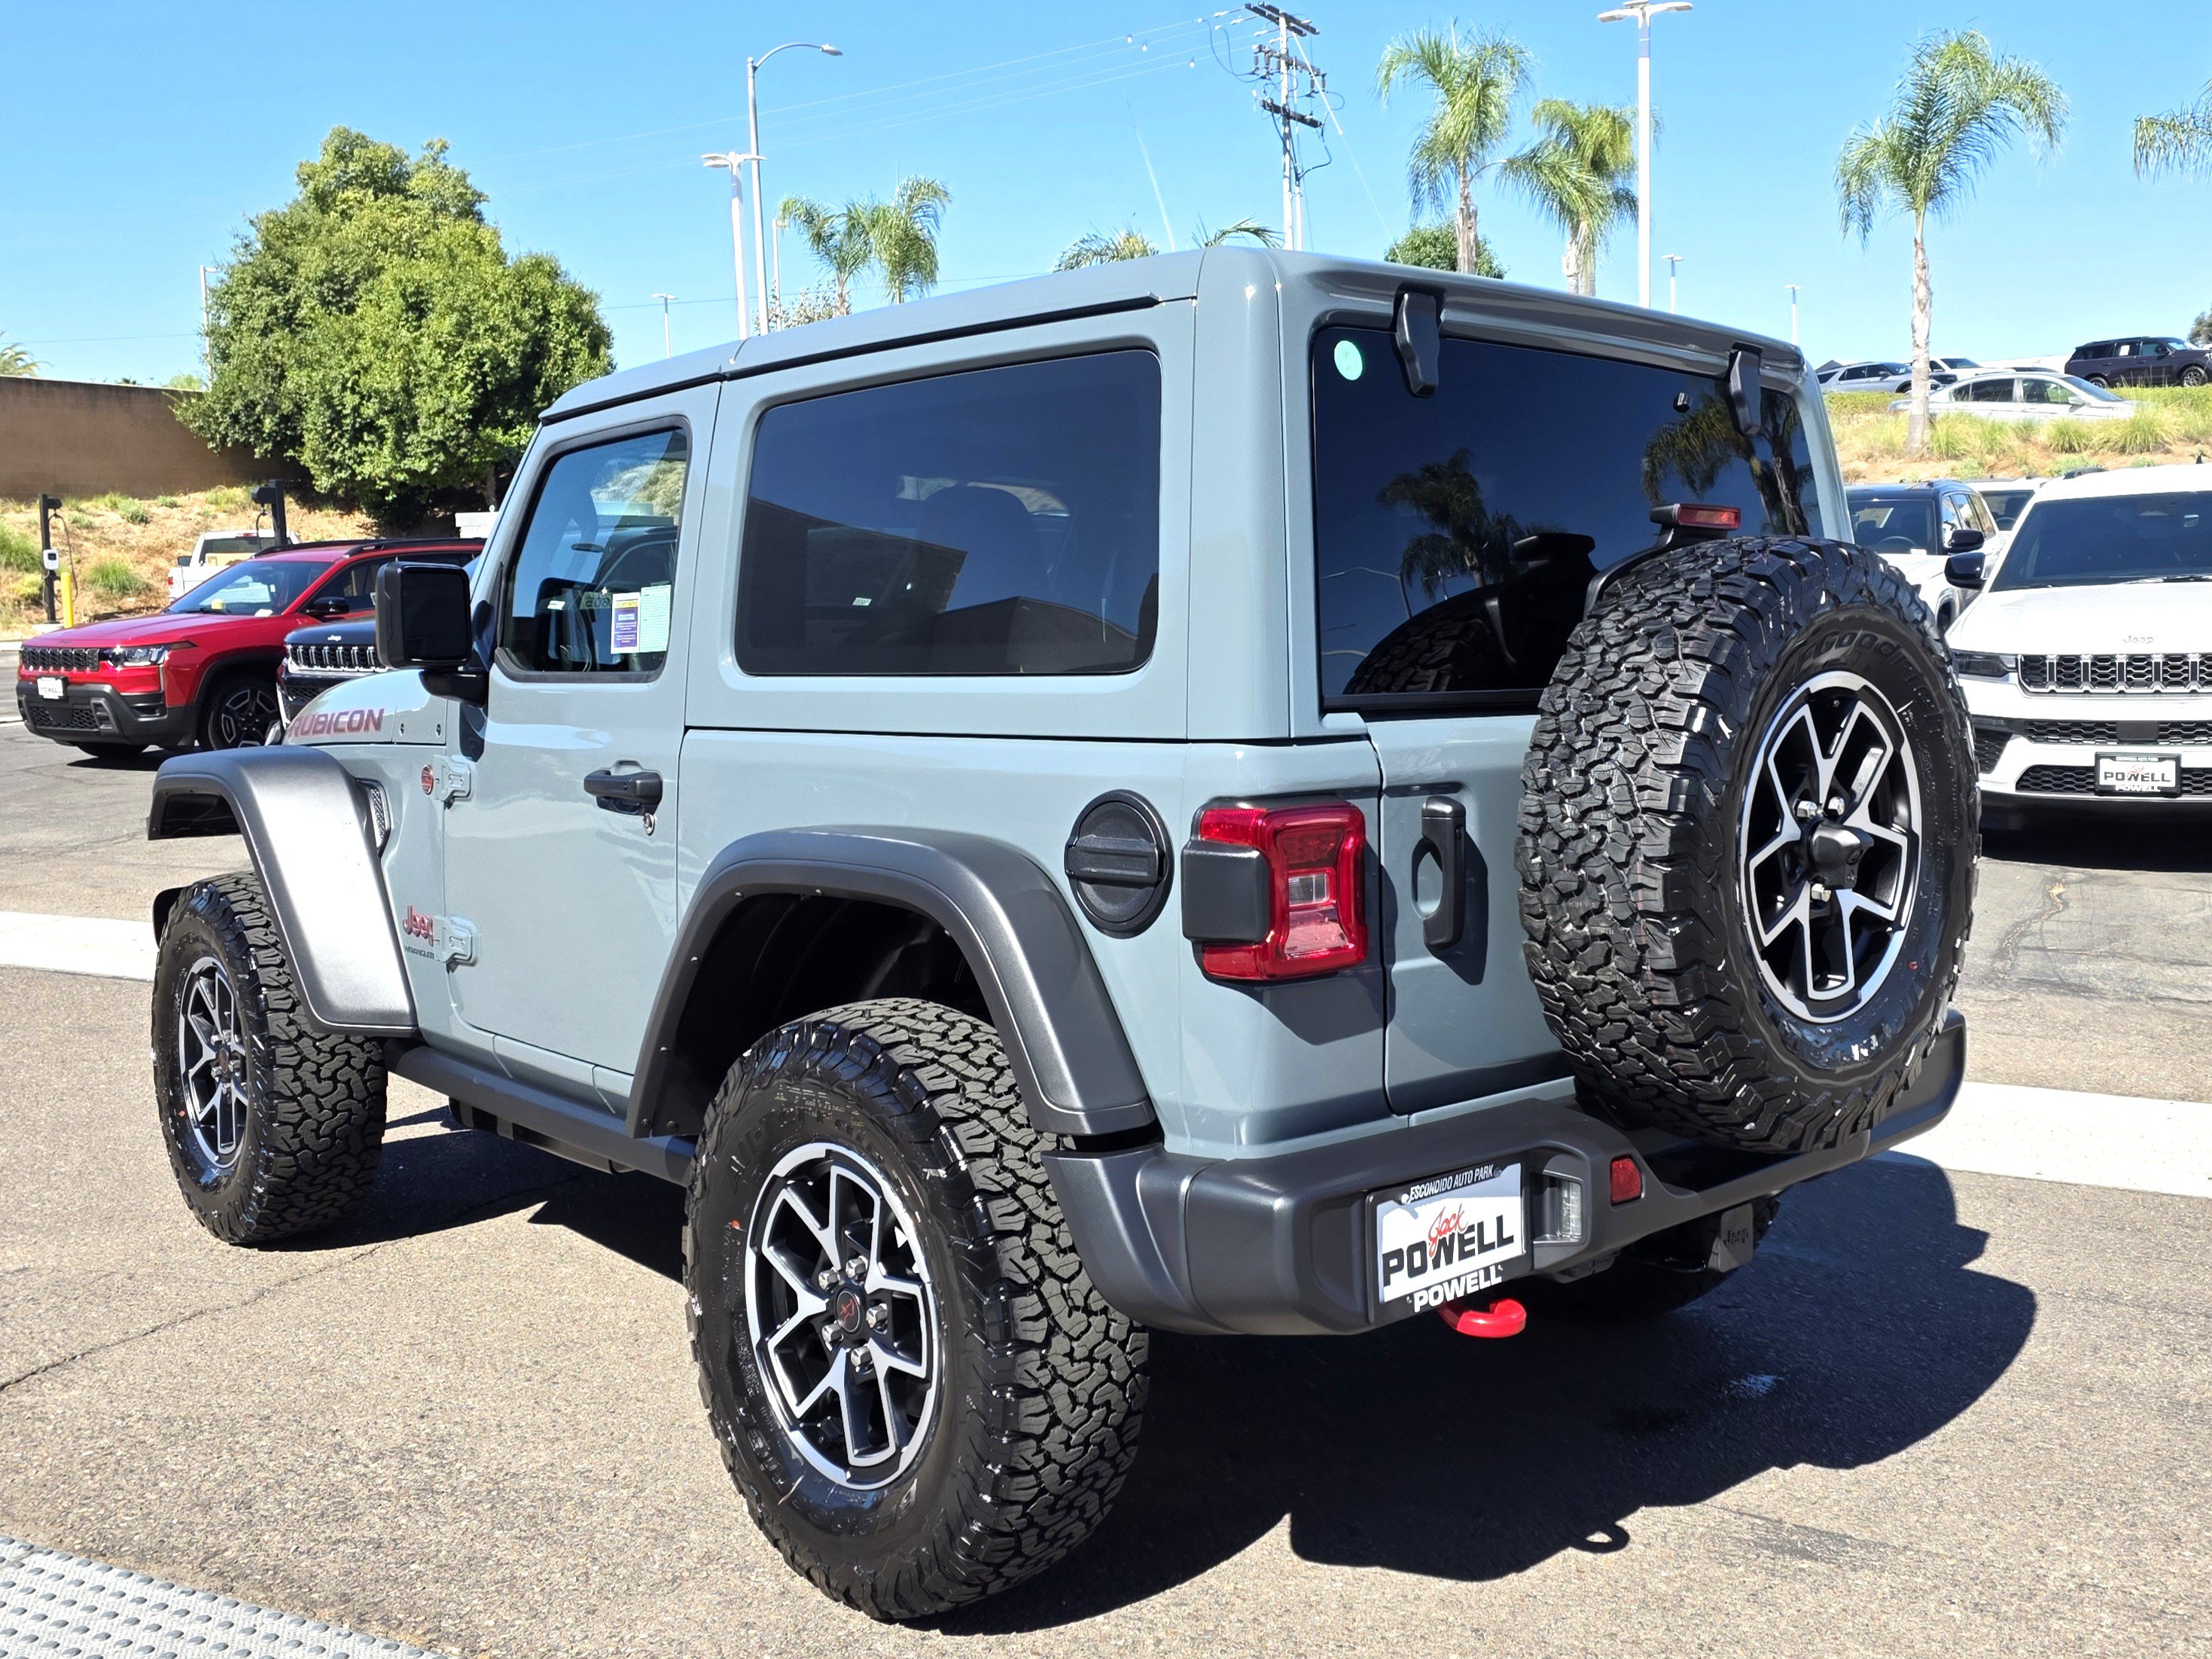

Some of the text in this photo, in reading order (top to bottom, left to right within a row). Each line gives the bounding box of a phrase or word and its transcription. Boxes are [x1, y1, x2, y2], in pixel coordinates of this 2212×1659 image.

[2122, 635, 2154, 644] Jeep
[289, 708, 385, 736] RUBICON
[2104, 771, 2171, 782] POWELL
[403, 904, 434, 947] Jeep
[403, 944, 434, 960] WRANGLER
[1409, 1163, 1494, 1202] ESCONDIDO AUTO PARK
[1428, 1203, 1469, 1258] Jack
[1382, 1215, 1514, 1287] POWELL
[1413, 1264, 1502, 1313] POWELL
